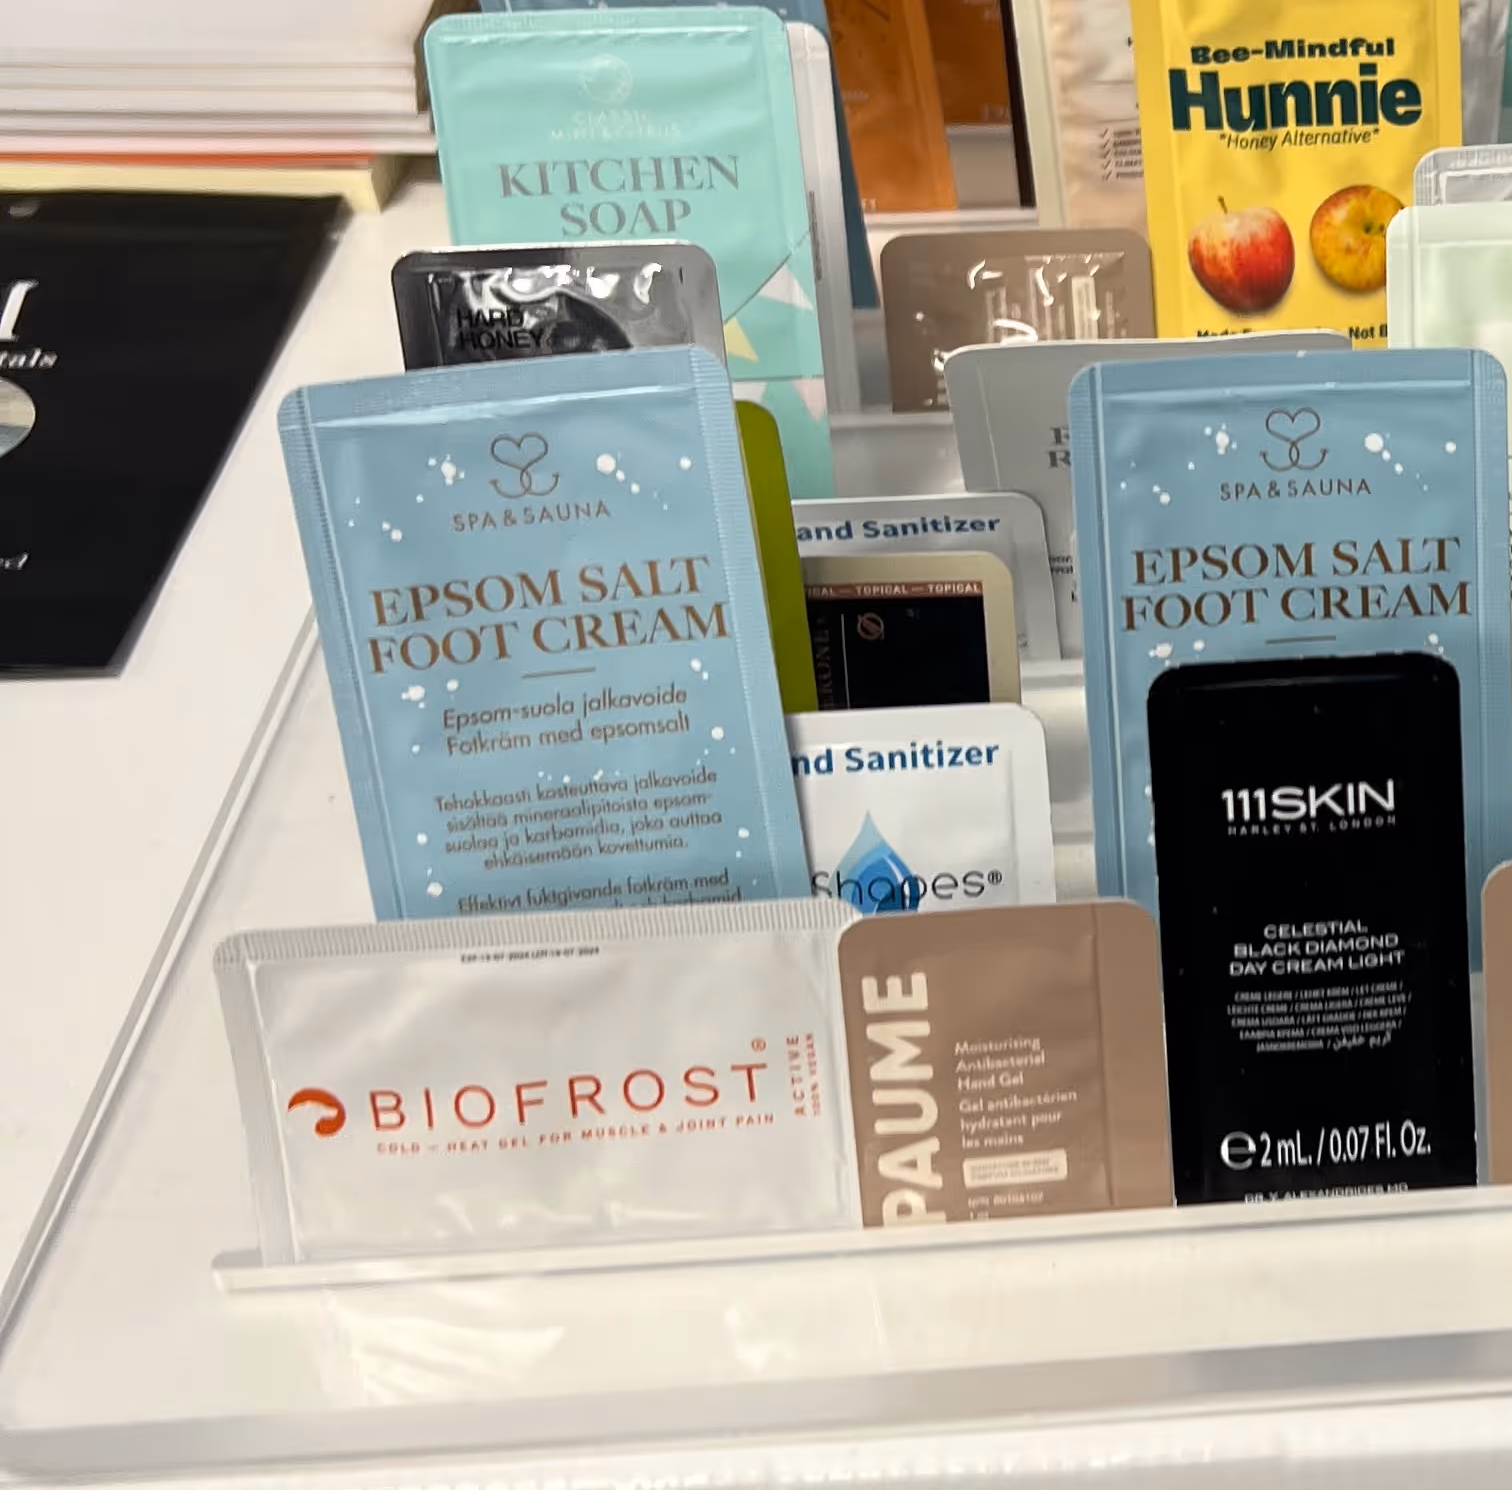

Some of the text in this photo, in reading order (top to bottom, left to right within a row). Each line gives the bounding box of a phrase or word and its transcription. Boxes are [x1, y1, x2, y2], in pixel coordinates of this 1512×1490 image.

[1191, 37, 1395, 65] Bee-Mindful
[1168, 63, 1423, 132] Hunnie
[499, 153, 740, 199] KITCHEN
[560, 198, 692, 238] SOAP
[457, 310, 524, 330] HARD
[458, 328, 545, 352] HONEY
[1220, 477, 1372, 502] SPA SAUNA
[453, 499, 611, 533] SPA SAUNA
[862, 515, 1001, 538] Sanitizer
[1131, 536, 1462, 586] EPSOM SALT
[368, 555, 712, 628] EPSOM SALT
[856, 581, 981, 595] TOPICAL TOPICAL
[1121, 581, 1473, 633] FOOT CREAM
[366, 600, 732, 674] FOOT CREAM
[442, 681, 688, 732] Epsom-suola jalkavoide
[446, 710, 690, 756] Fotkräm med epsomsalt
[845, 740, 1000, 773] Sanitizer
[1221, 778, 1395, 822] 111SKIN
[1227, 815, 1396, 836] HARLEY LONDON
[525, 867, 729, 908] fuktgivande fotkräm med
[1233, 932, 1399, 959] BLACK DIAMOND
[1263, 919, 1368, 940] CELESTIAL
[1229, 949, 1405, 977] DAY CREAM LIGHT
[786, 1035, 806, 1116] ACTIVE
[956, 1052, 1045, 1073] Antibacterial
[957, 1072, 1024, 1090] Hand Gel
[862, 972, 947, 1228] PAUME
[959, 1098, 983, 1113] Gel
[377, 1114, 774, 1155] COLD HEAT GEL FOR MUSCLE JOINT PAIN
[960, 1111, 1062, 1134] hydratant pour
[984, 1132, 1024, 1146] mains
[1260, 1118, 1431, 1167] 2 0.07 Fl. Oz.
